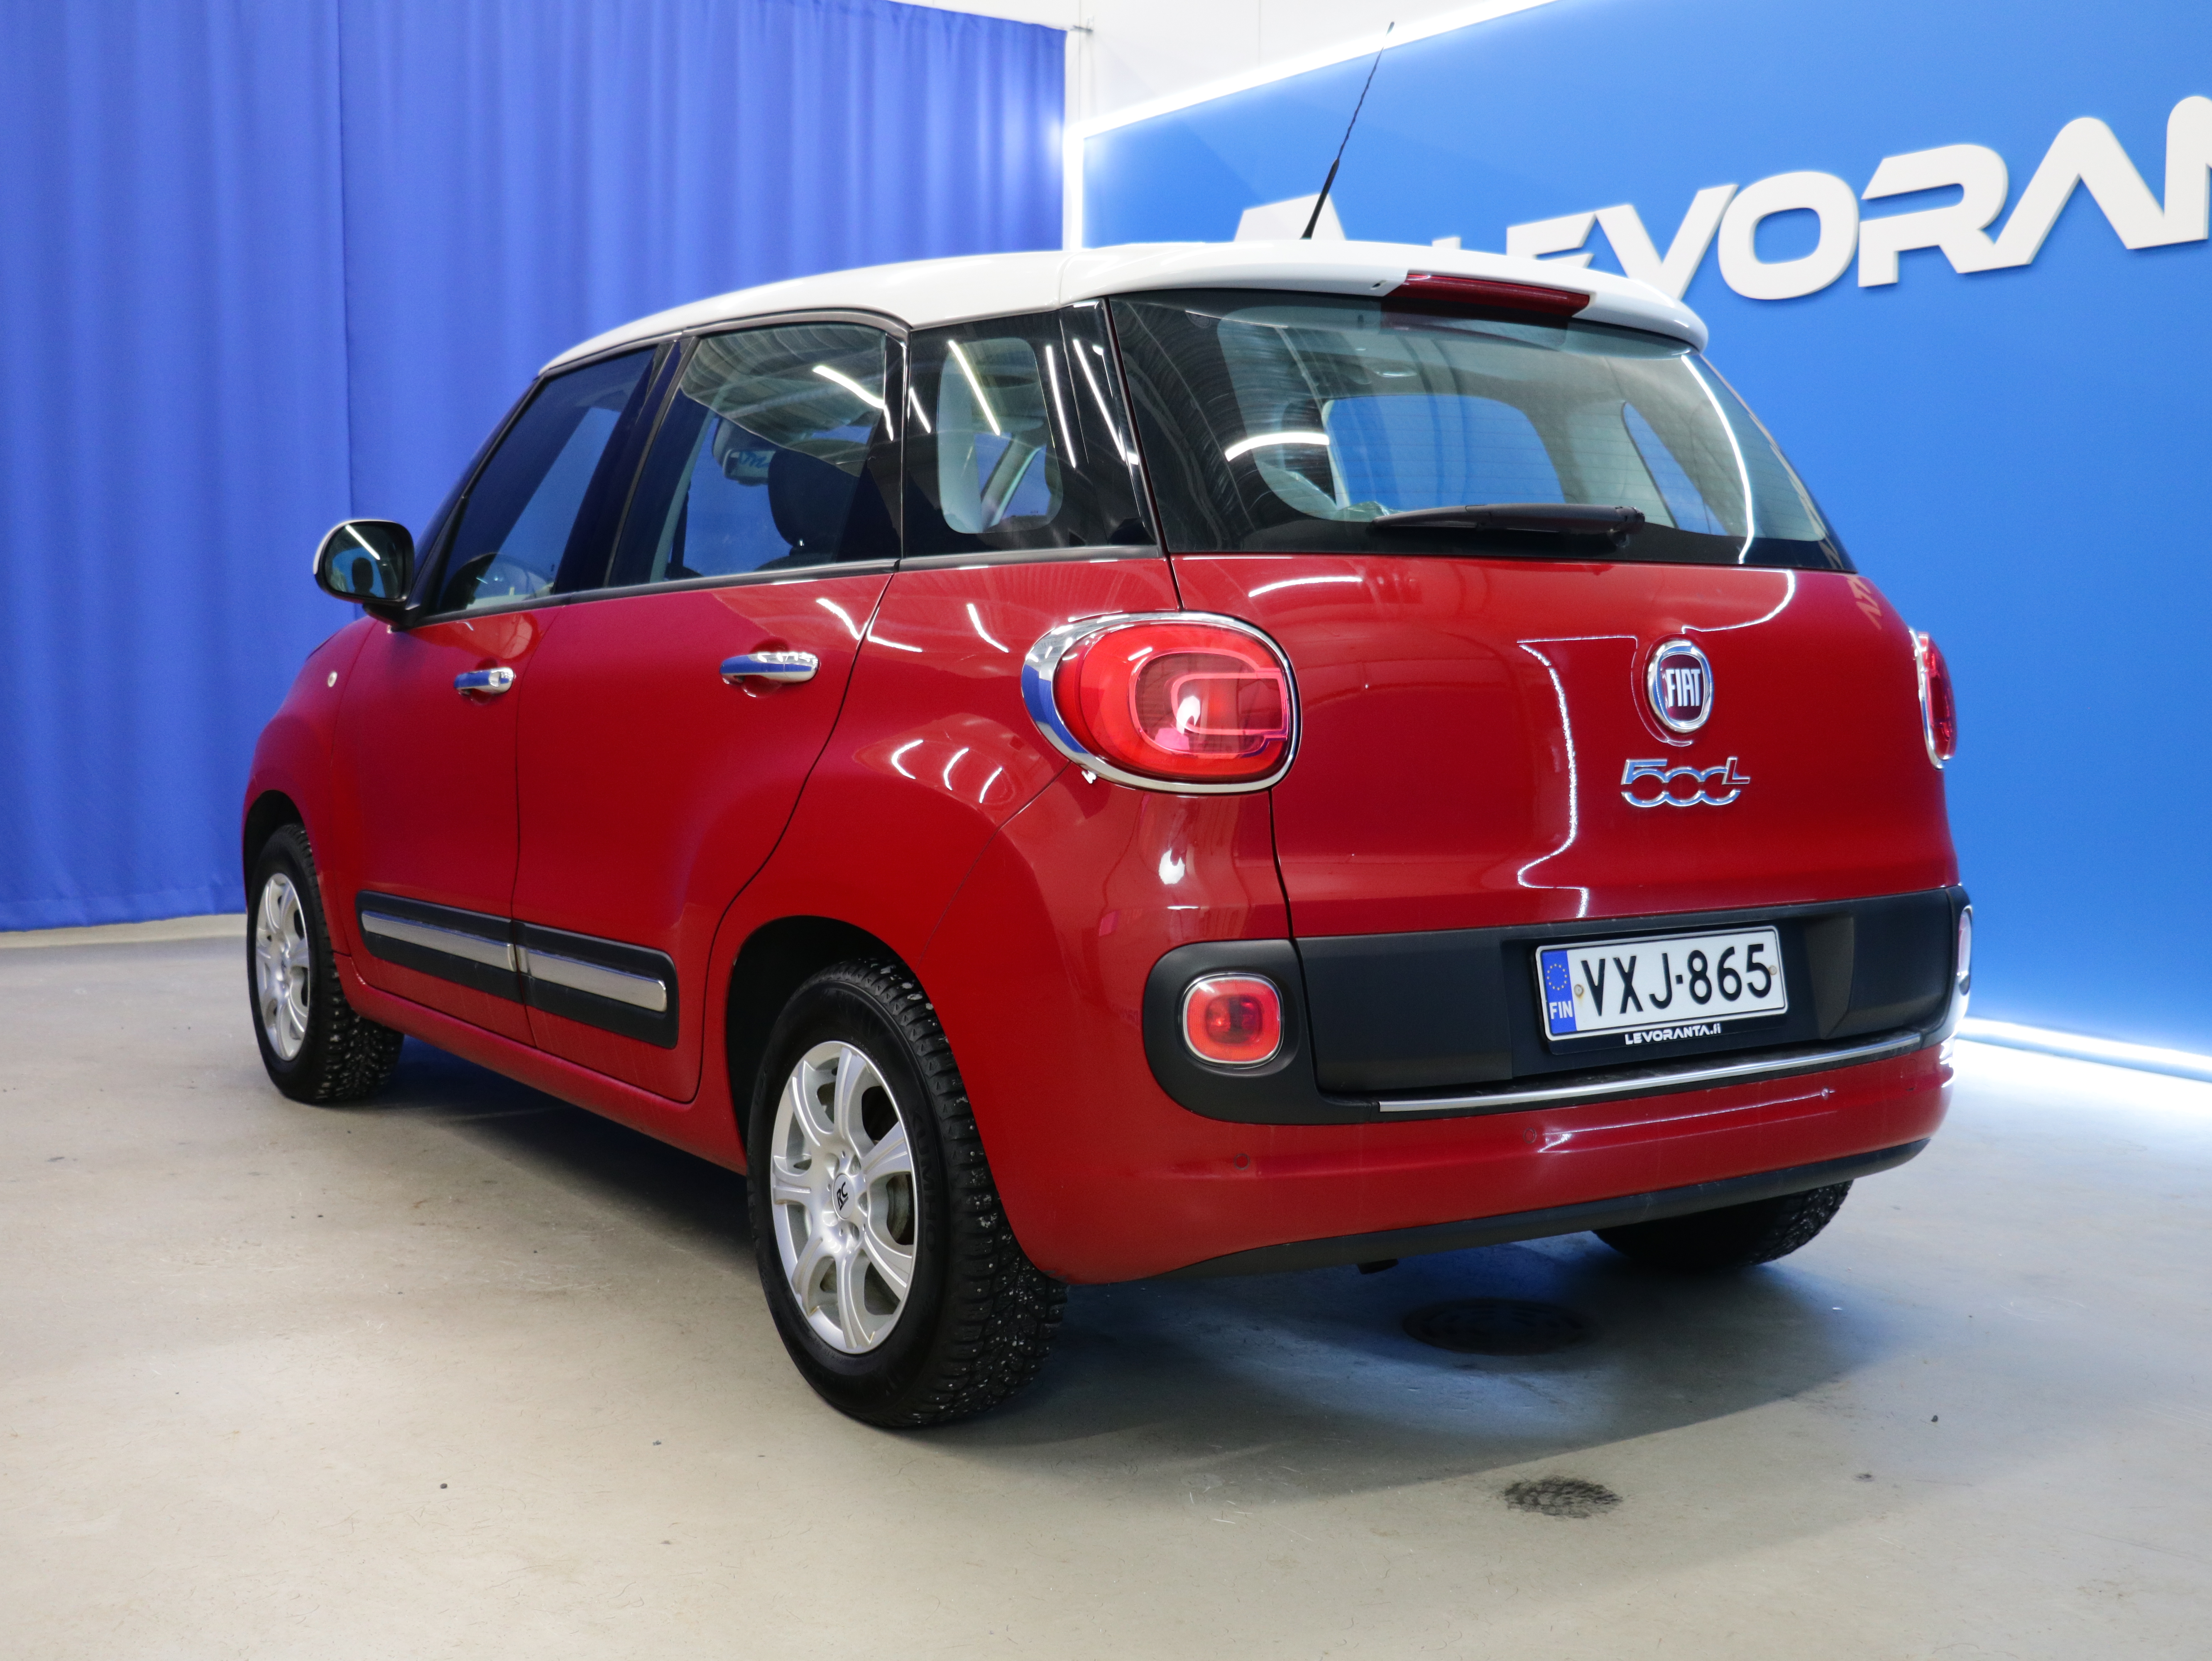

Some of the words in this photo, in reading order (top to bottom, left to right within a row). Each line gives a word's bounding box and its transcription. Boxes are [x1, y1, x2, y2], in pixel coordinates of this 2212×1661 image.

[1665, 668, 1701, 708] FIAT
[1620, 756, 1751, 808] 500L
[1581, 943, 1772, 1017] VXJ-865
[1549, 1000, 1573, 1020] FIN
[1625, 1023, 1721, 1045] LEVORANTA.fi
[837, 1181, 849, 1211] RC
[912, 1110, 937, 1252] KUMHO
